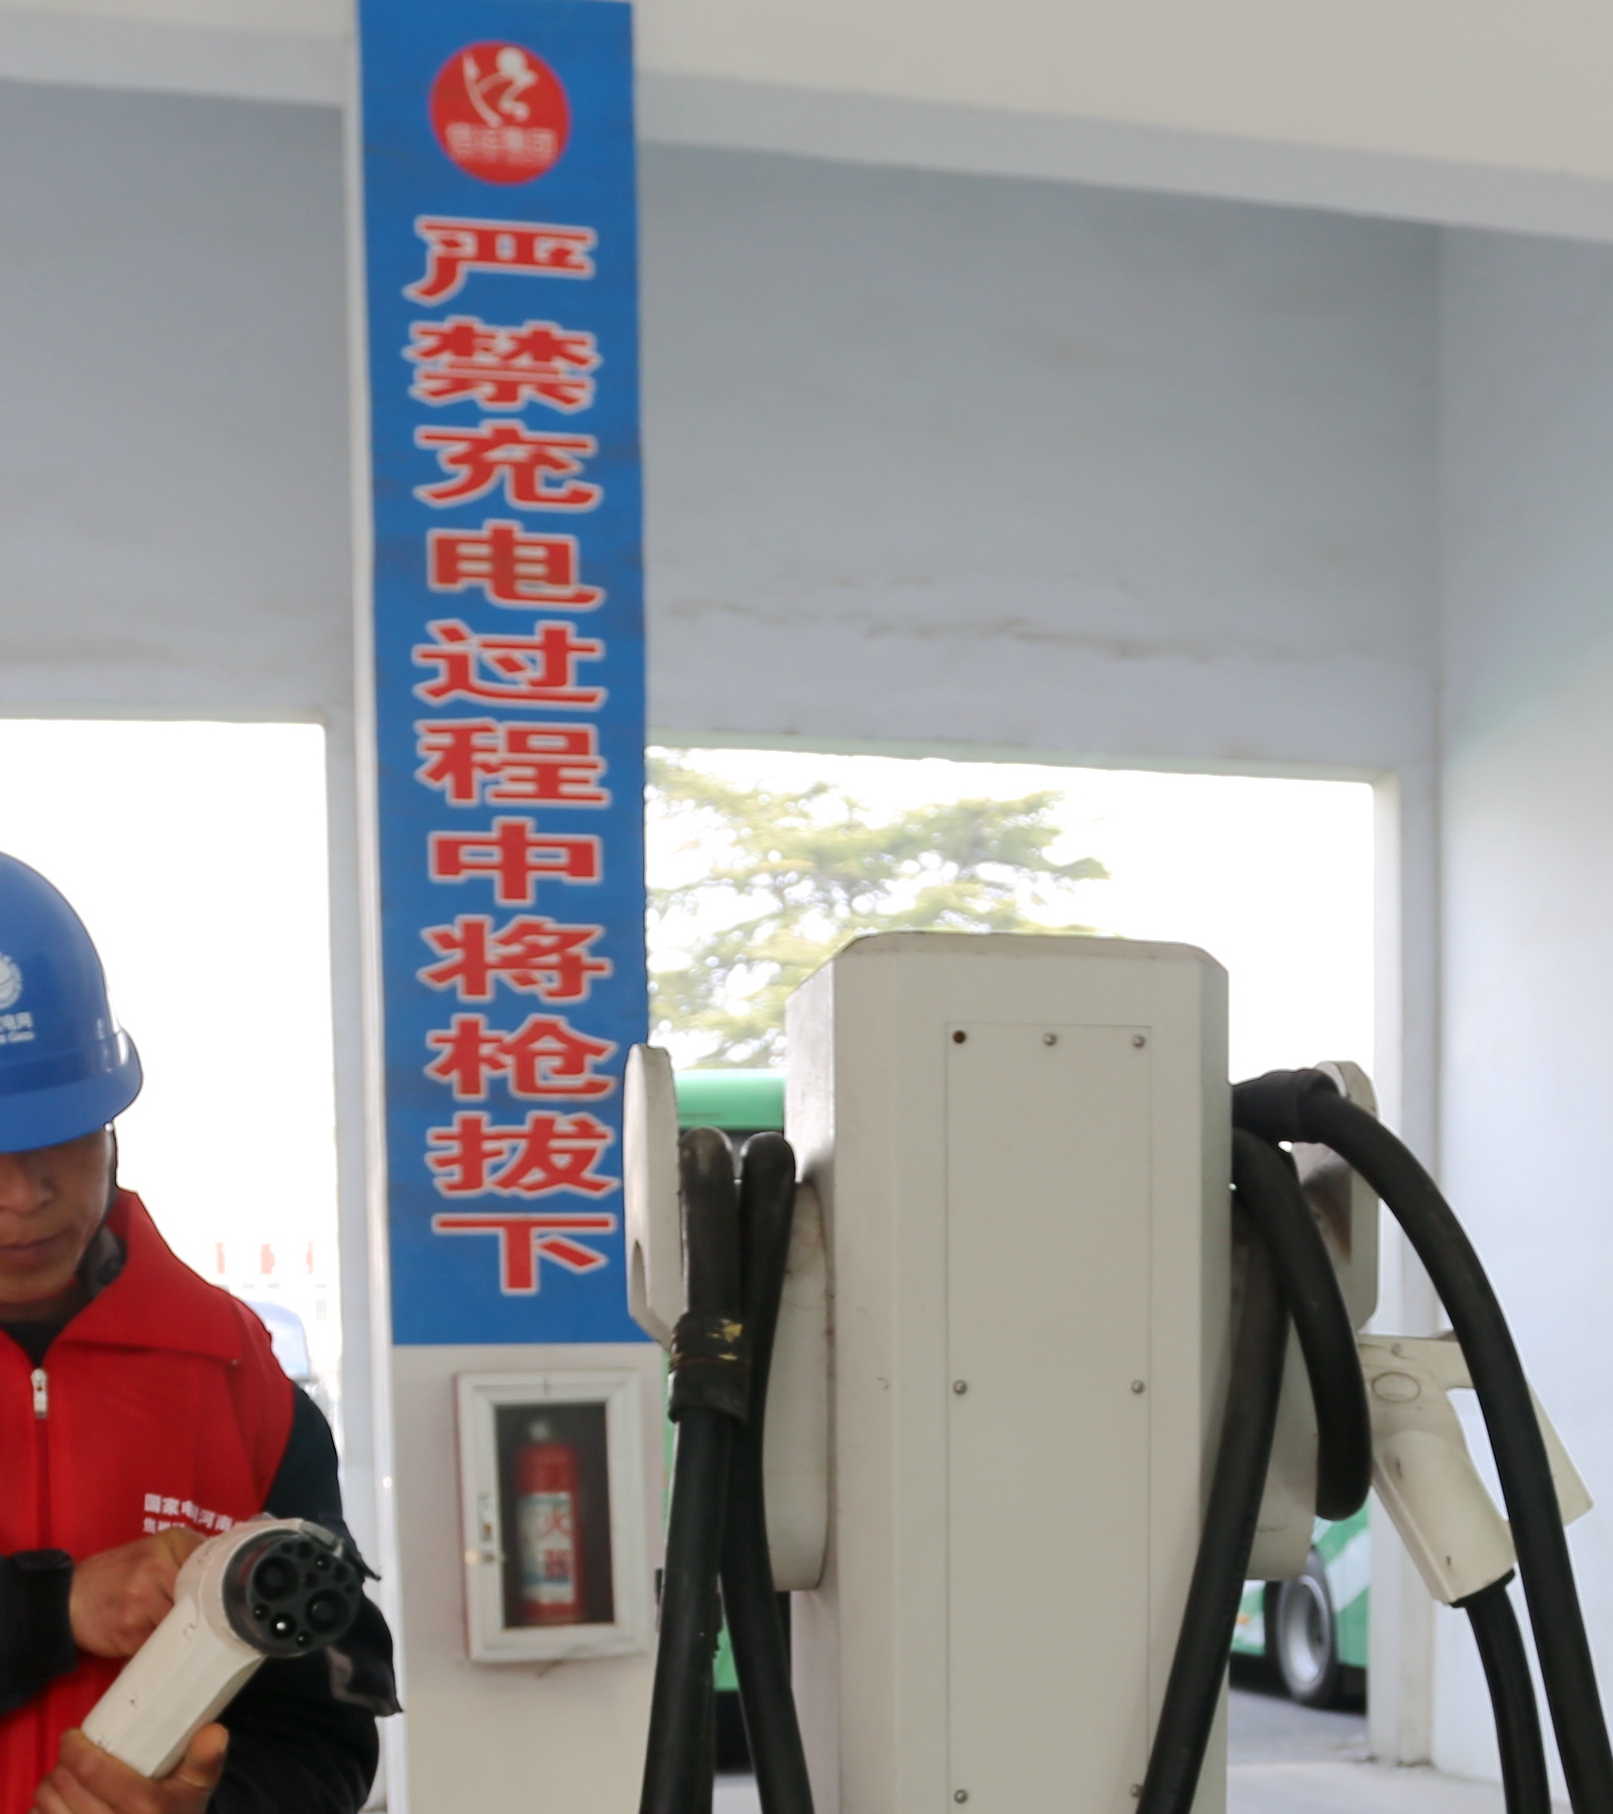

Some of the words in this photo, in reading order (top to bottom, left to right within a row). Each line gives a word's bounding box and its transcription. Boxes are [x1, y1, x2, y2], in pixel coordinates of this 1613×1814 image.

[401, 214, 623, 1296] 严禁充电过程中将枪拔下
